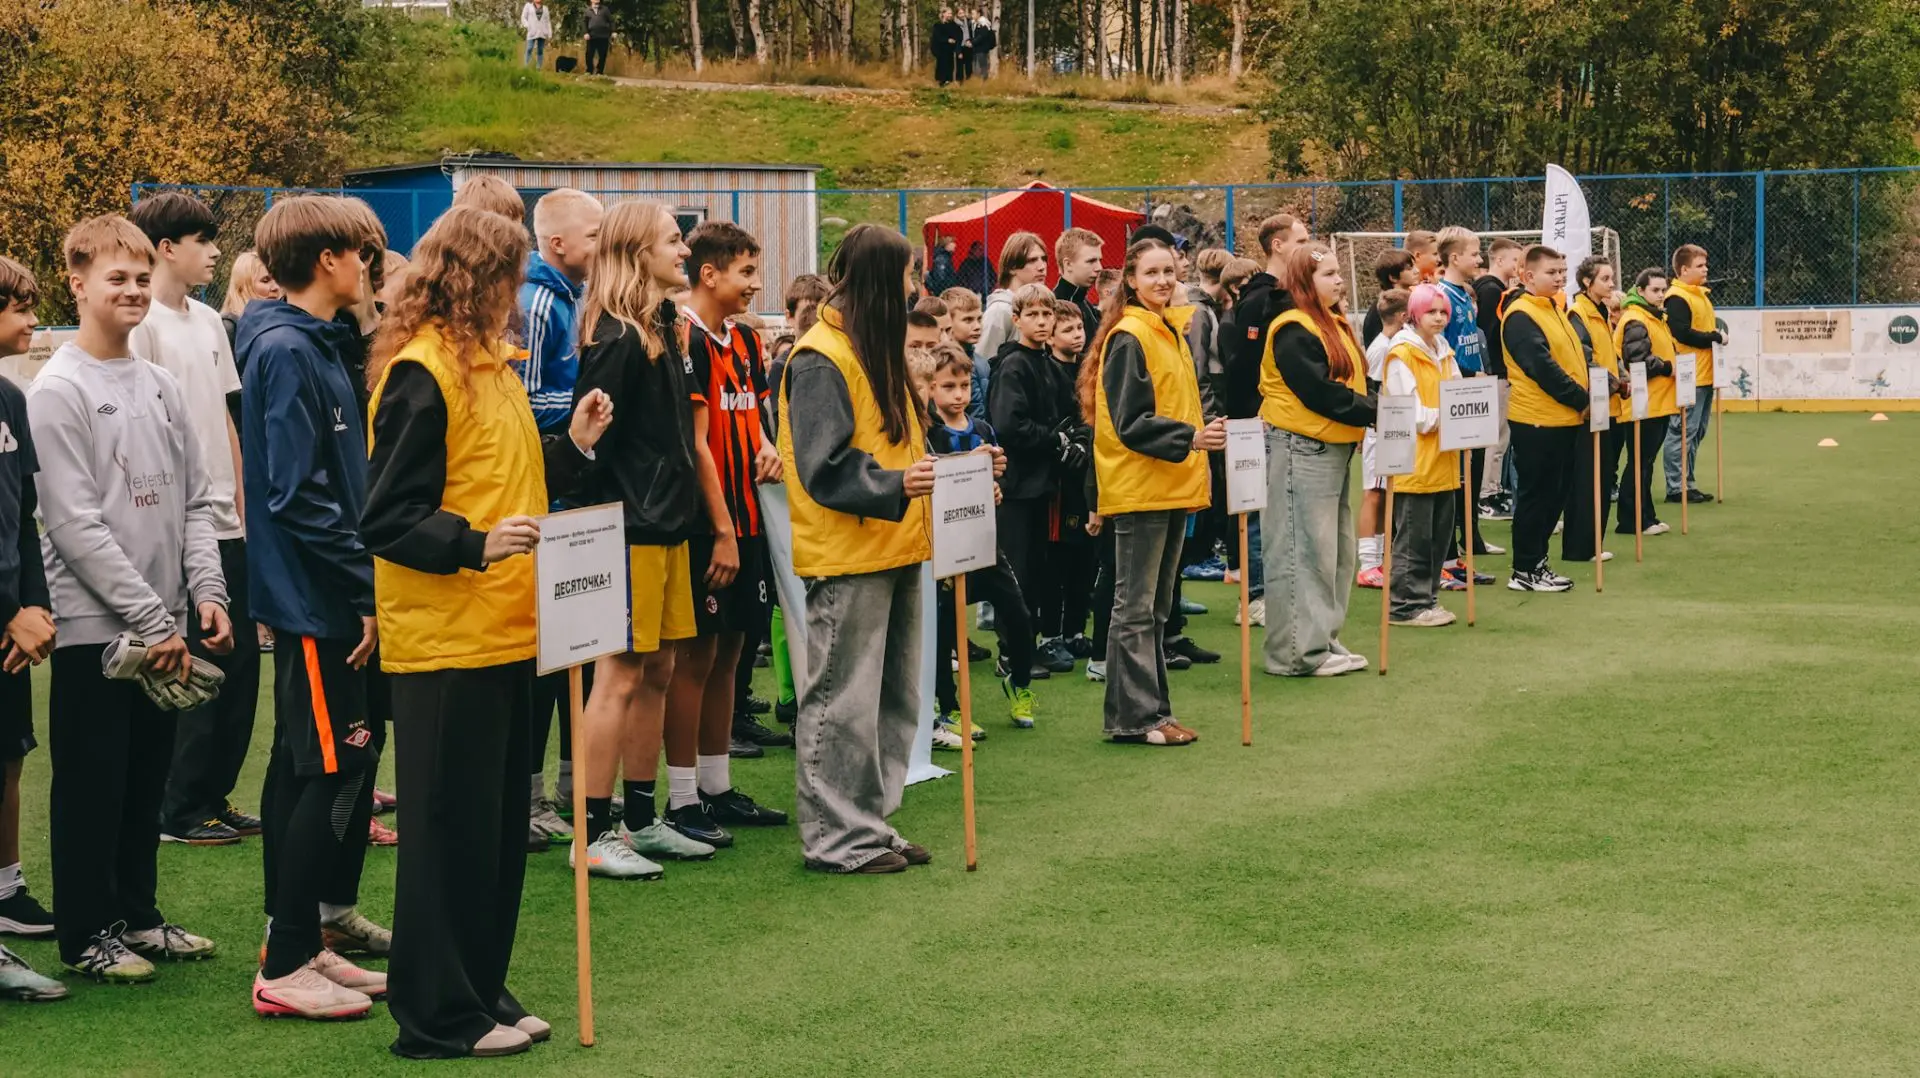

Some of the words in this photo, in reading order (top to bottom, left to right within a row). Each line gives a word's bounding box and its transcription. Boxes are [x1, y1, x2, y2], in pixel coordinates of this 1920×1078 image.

[719, 385, 755, 410] bwin
[1450, 401, 1489, 417] СОПКИ
[943, 504, 986, 523] ДЕСЯТОЧКА-2
[554, 572, 612, 600] ДЕСЯТОЧКА-1
[758, 580, 768, 603] 8
